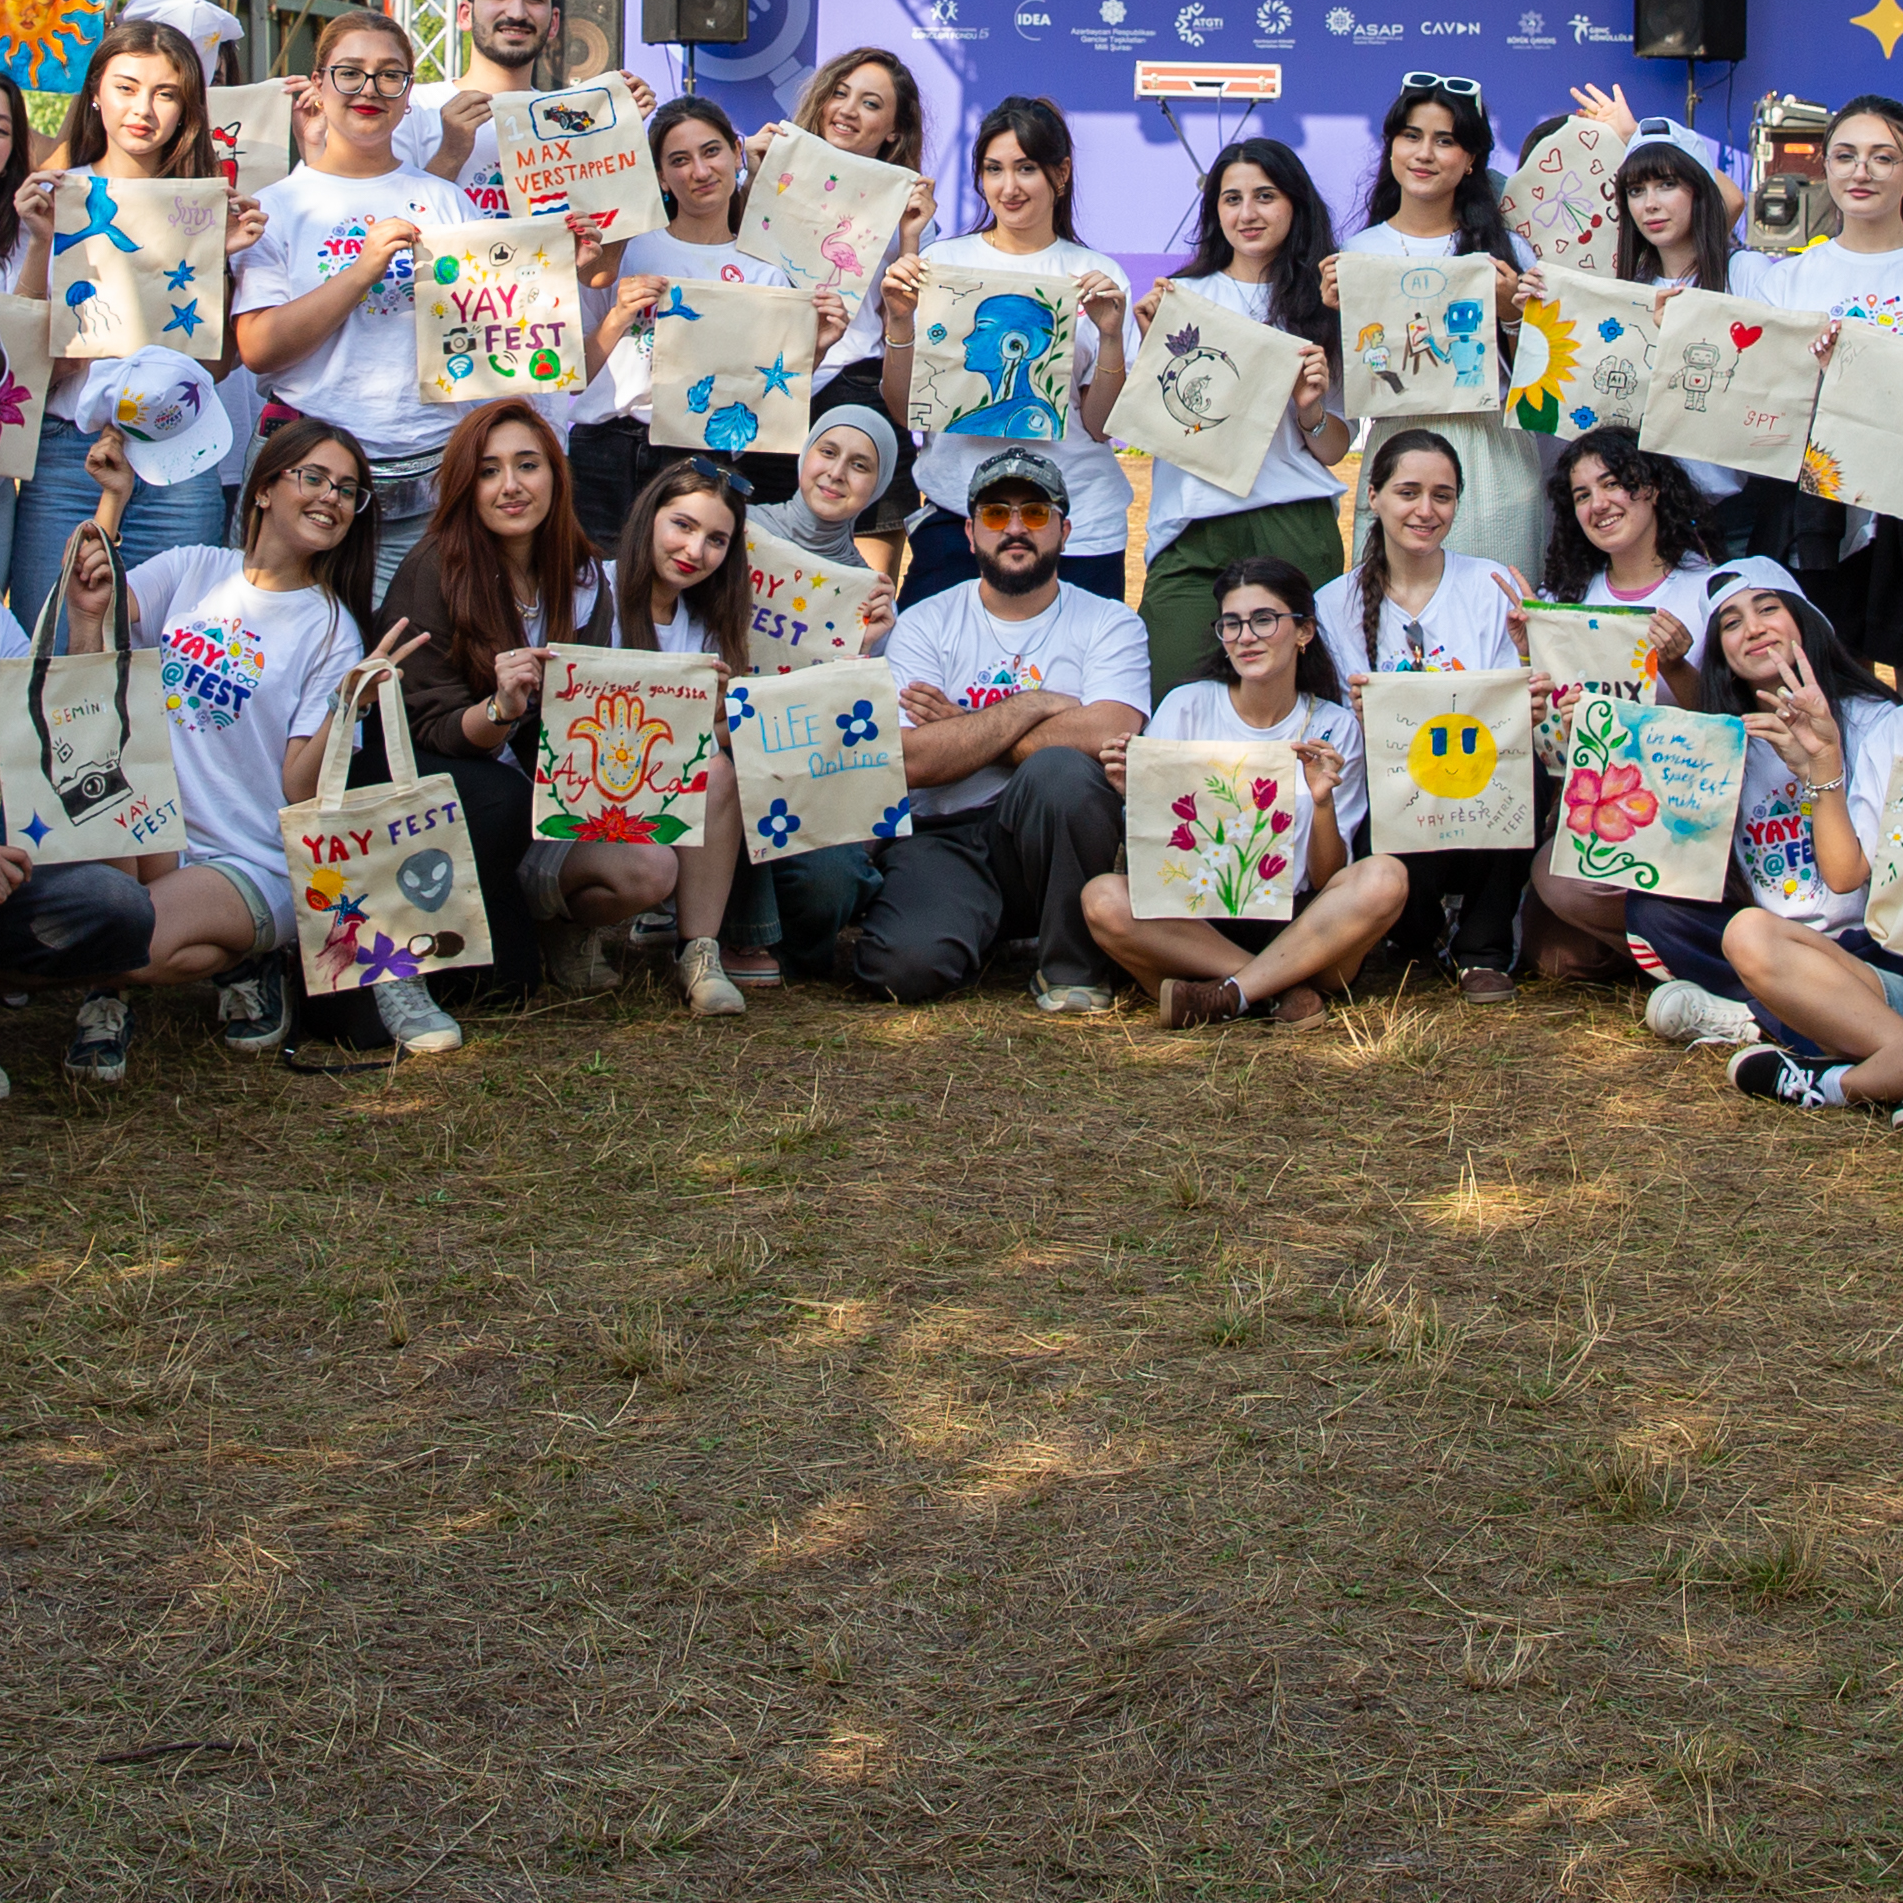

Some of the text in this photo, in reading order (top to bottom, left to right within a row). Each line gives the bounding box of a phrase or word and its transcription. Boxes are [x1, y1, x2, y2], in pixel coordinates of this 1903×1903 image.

[1017, 13, 1051, 25] IDEA
[1353, 23, 1404, 36] ASAP
[515, 140, 572, 169] MAX
[514, 150, 638, 194] VERSTAPPEN
[324, 238, 365, 256] YA
[1412, 275, 1429, 290] AI
[450, 284, 518, 323] YAY
[485, 323, 566, 352] FEST
[1611, 375, 1621, 383] AI
[171, 628, 226, 668] YAY
[555, 662, 708, 703] Spiritual gangsta
[1647, 727, 1664, 745] in
[113, 794, 152, 830] YAY
[131, 799, 178, 846] FEST
[1417, 809, 1485, 828] YAY FEST
[1486, 794, 1515, 829] MATRIX
[1502, 803, 1527, 835] TEAM
[302, 801, 460, 866] YAY FEST
[1745, 815, 1802, 847] YAY
[1763, 838, 1815, 877] @FE
